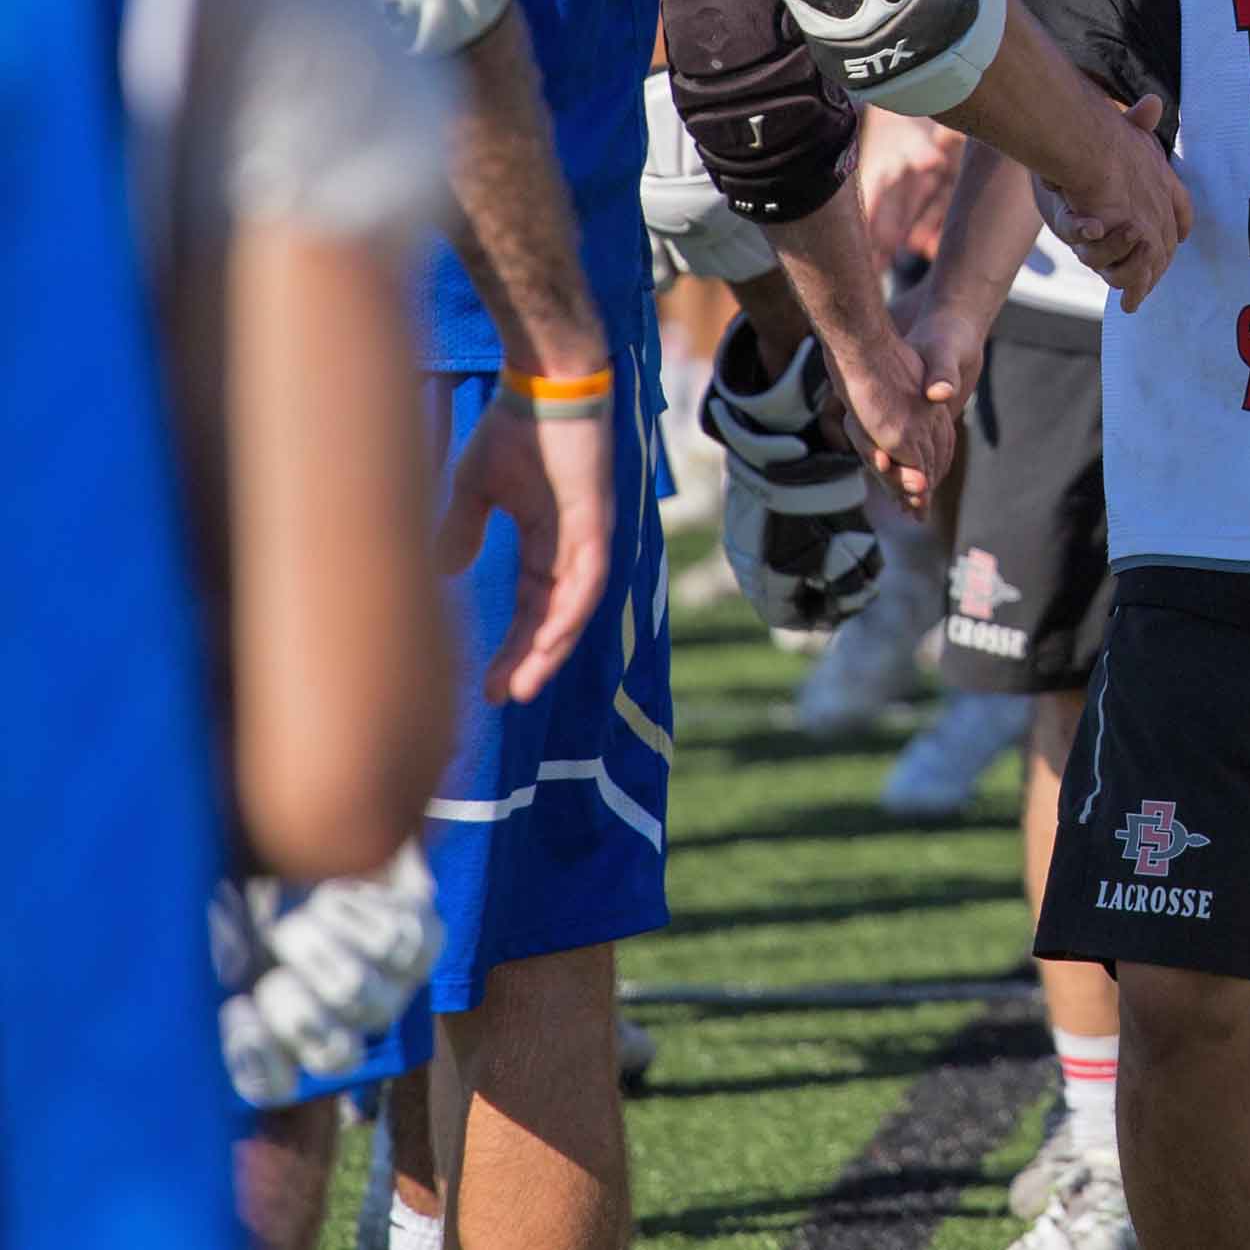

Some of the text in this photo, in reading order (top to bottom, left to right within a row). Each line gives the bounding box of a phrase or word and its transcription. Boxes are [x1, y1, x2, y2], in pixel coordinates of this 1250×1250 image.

[843, 38, 915, 80] STX
[947, 614, 1027, 660] CROSSE
[1095, 879, 1214, 919] LACROSSE
